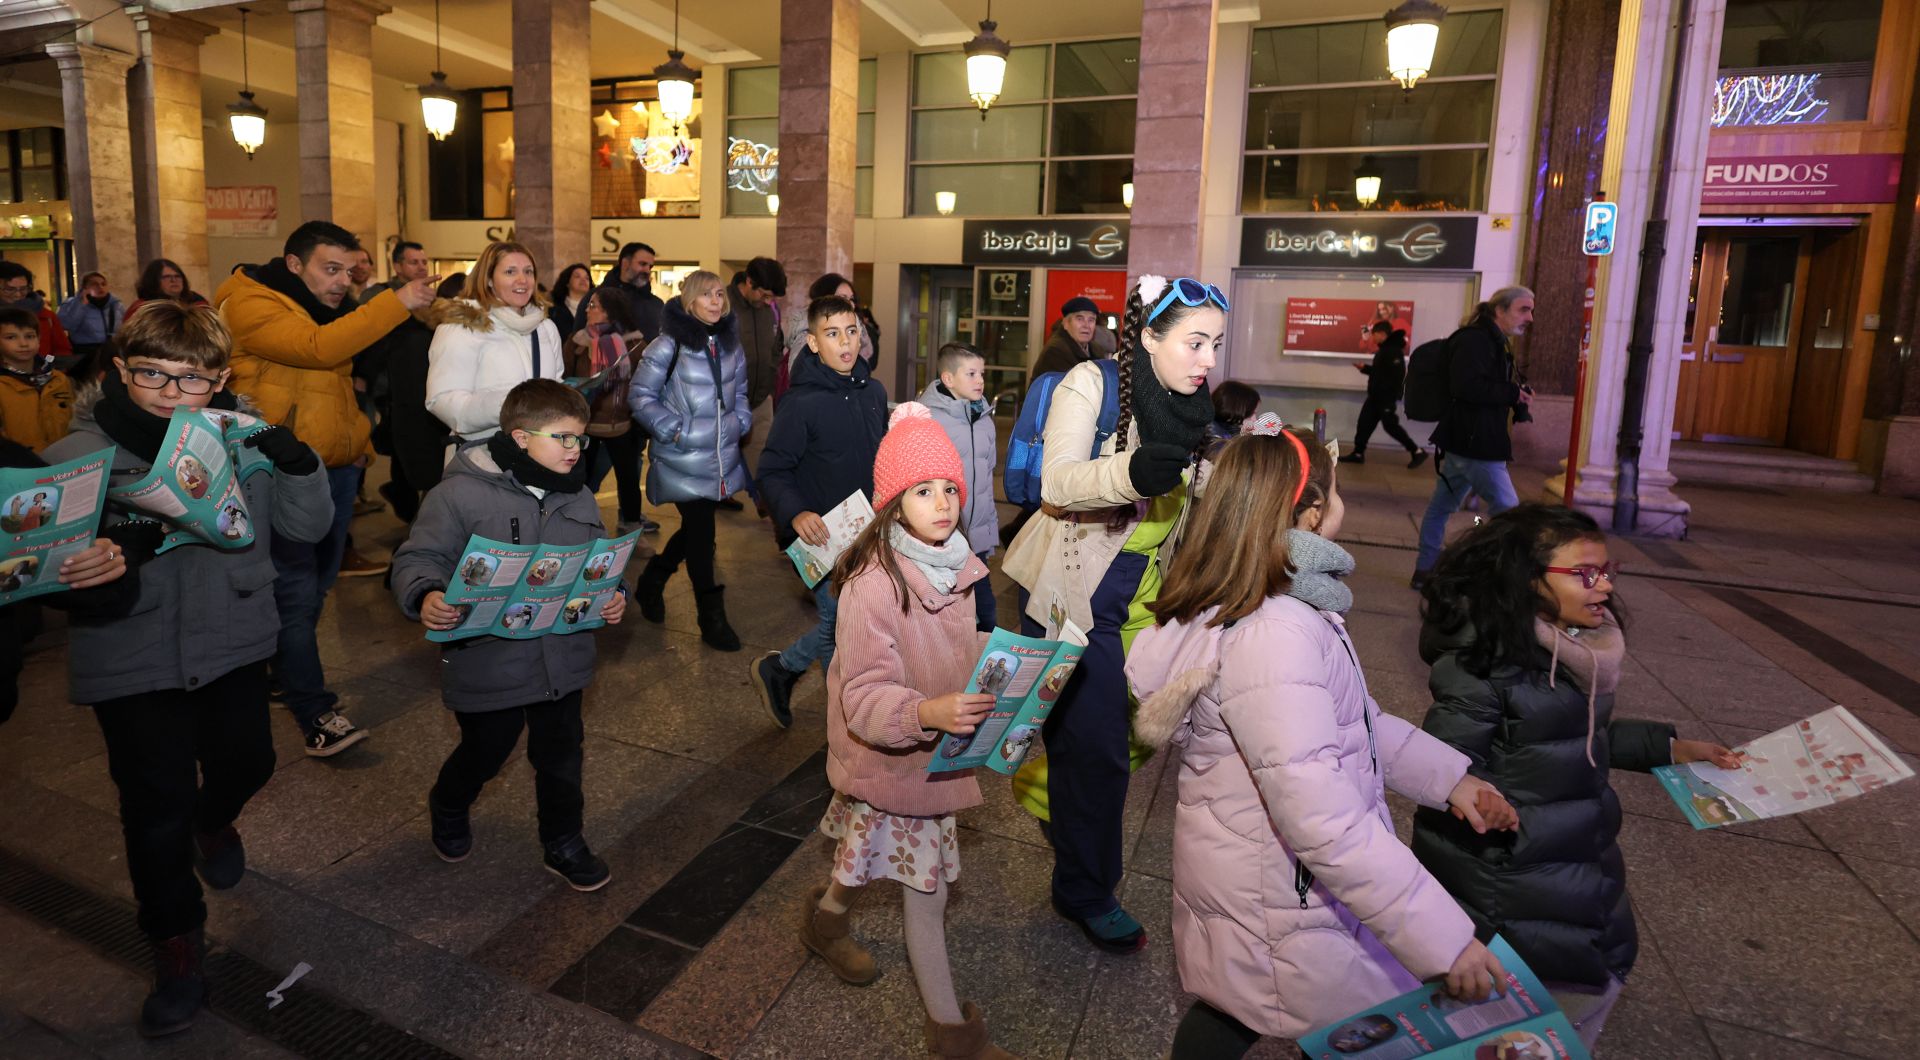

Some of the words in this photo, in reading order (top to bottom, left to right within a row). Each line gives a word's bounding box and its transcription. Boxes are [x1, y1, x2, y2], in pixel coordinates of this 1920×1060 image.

[1705, 163, 1829, 183] FUNDOS
[240, 189, 273, 208] VENTA
[1591, 208, 1612, 233] P
[982, 230, 1070, 256] iberCaja
[1266, 229, 1378, 258] iberCaja
